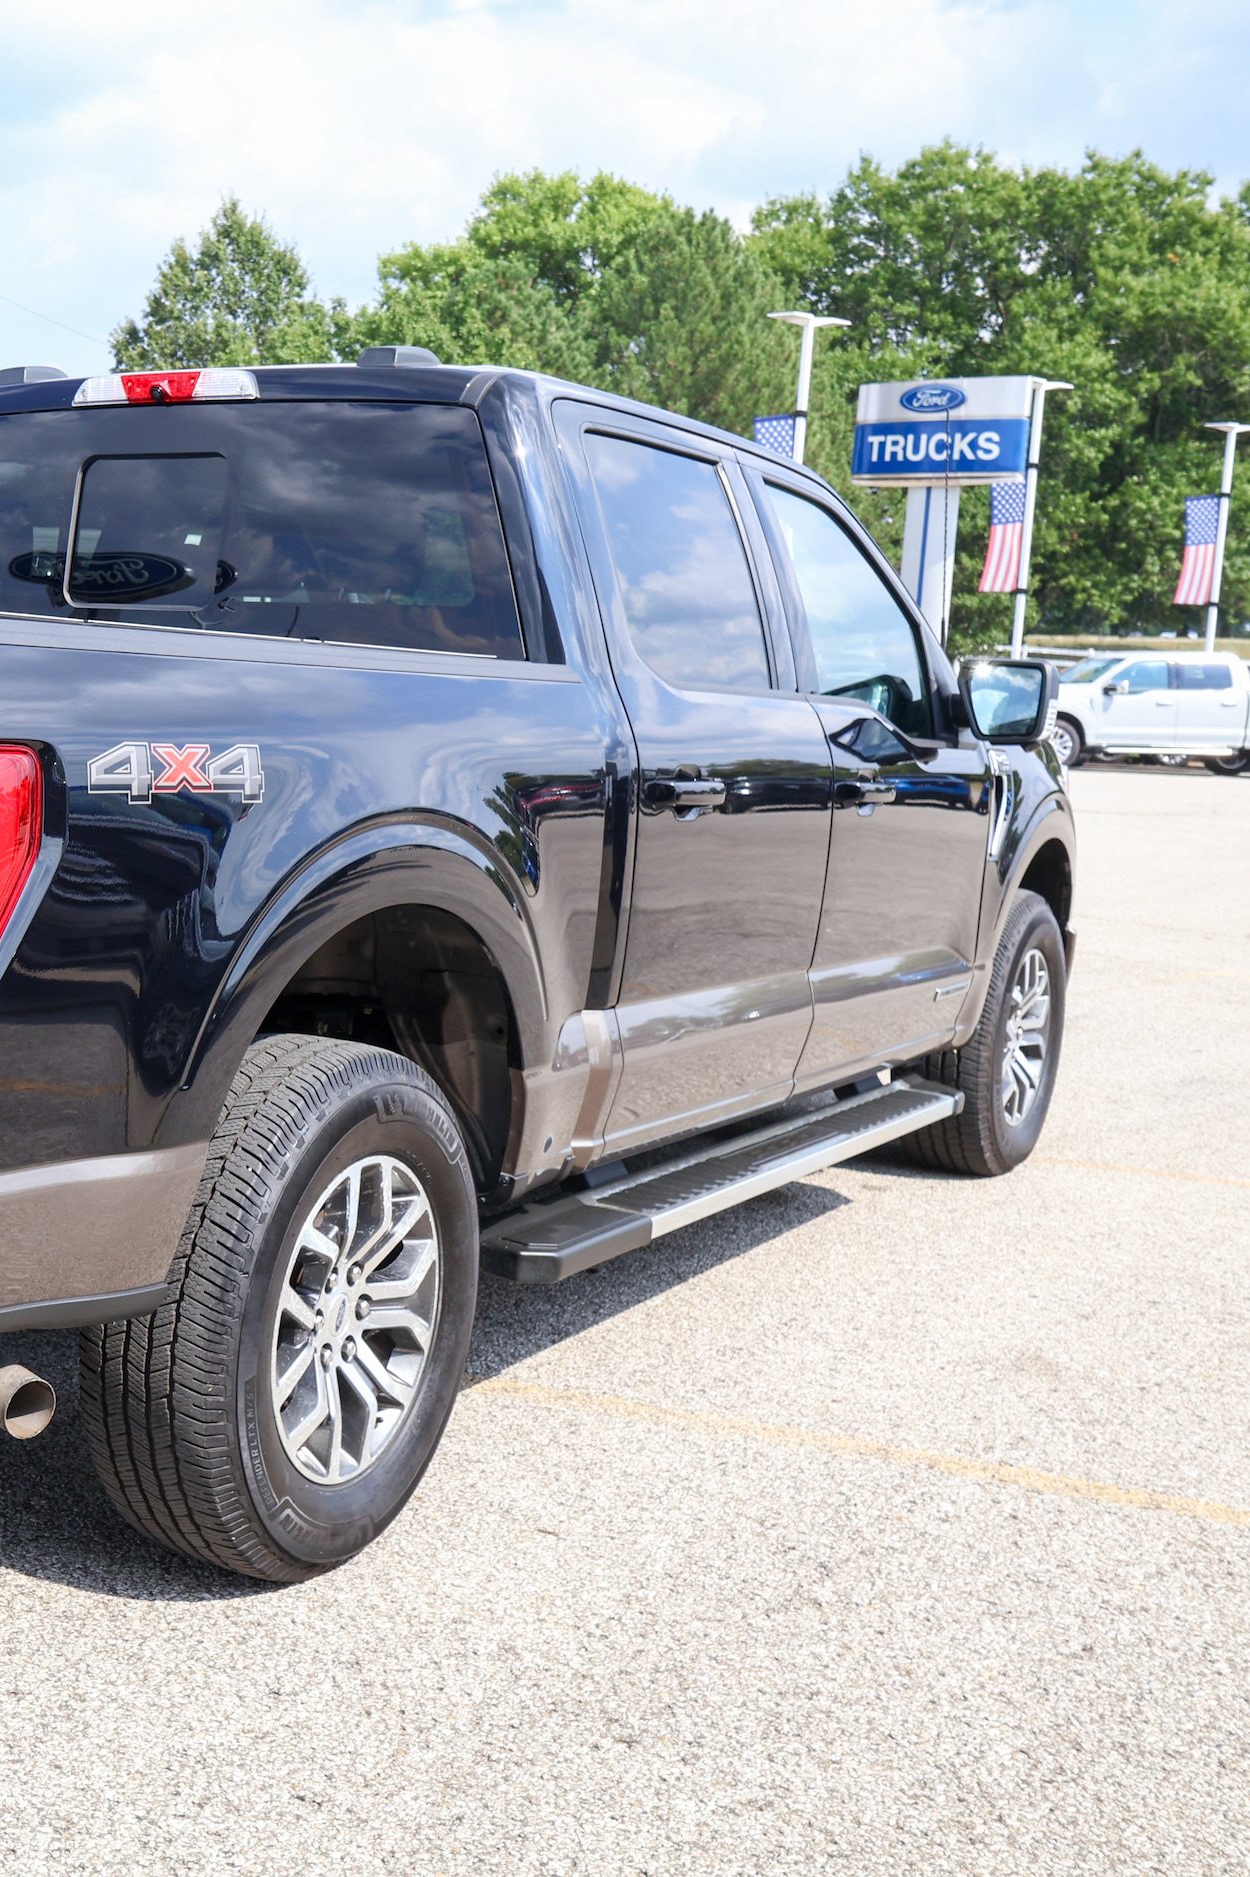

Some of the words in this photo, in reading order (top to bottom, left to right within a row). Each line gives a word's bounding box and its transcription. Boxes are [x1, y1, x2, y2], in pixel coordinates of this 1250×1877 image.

[912, 388, 950, 408] Ford
[867, 431, 1001, 463] TRUCKS
[246, 1422, 258, 1447] LTX
[251, 1449, 275, 1506] DEFENDER
